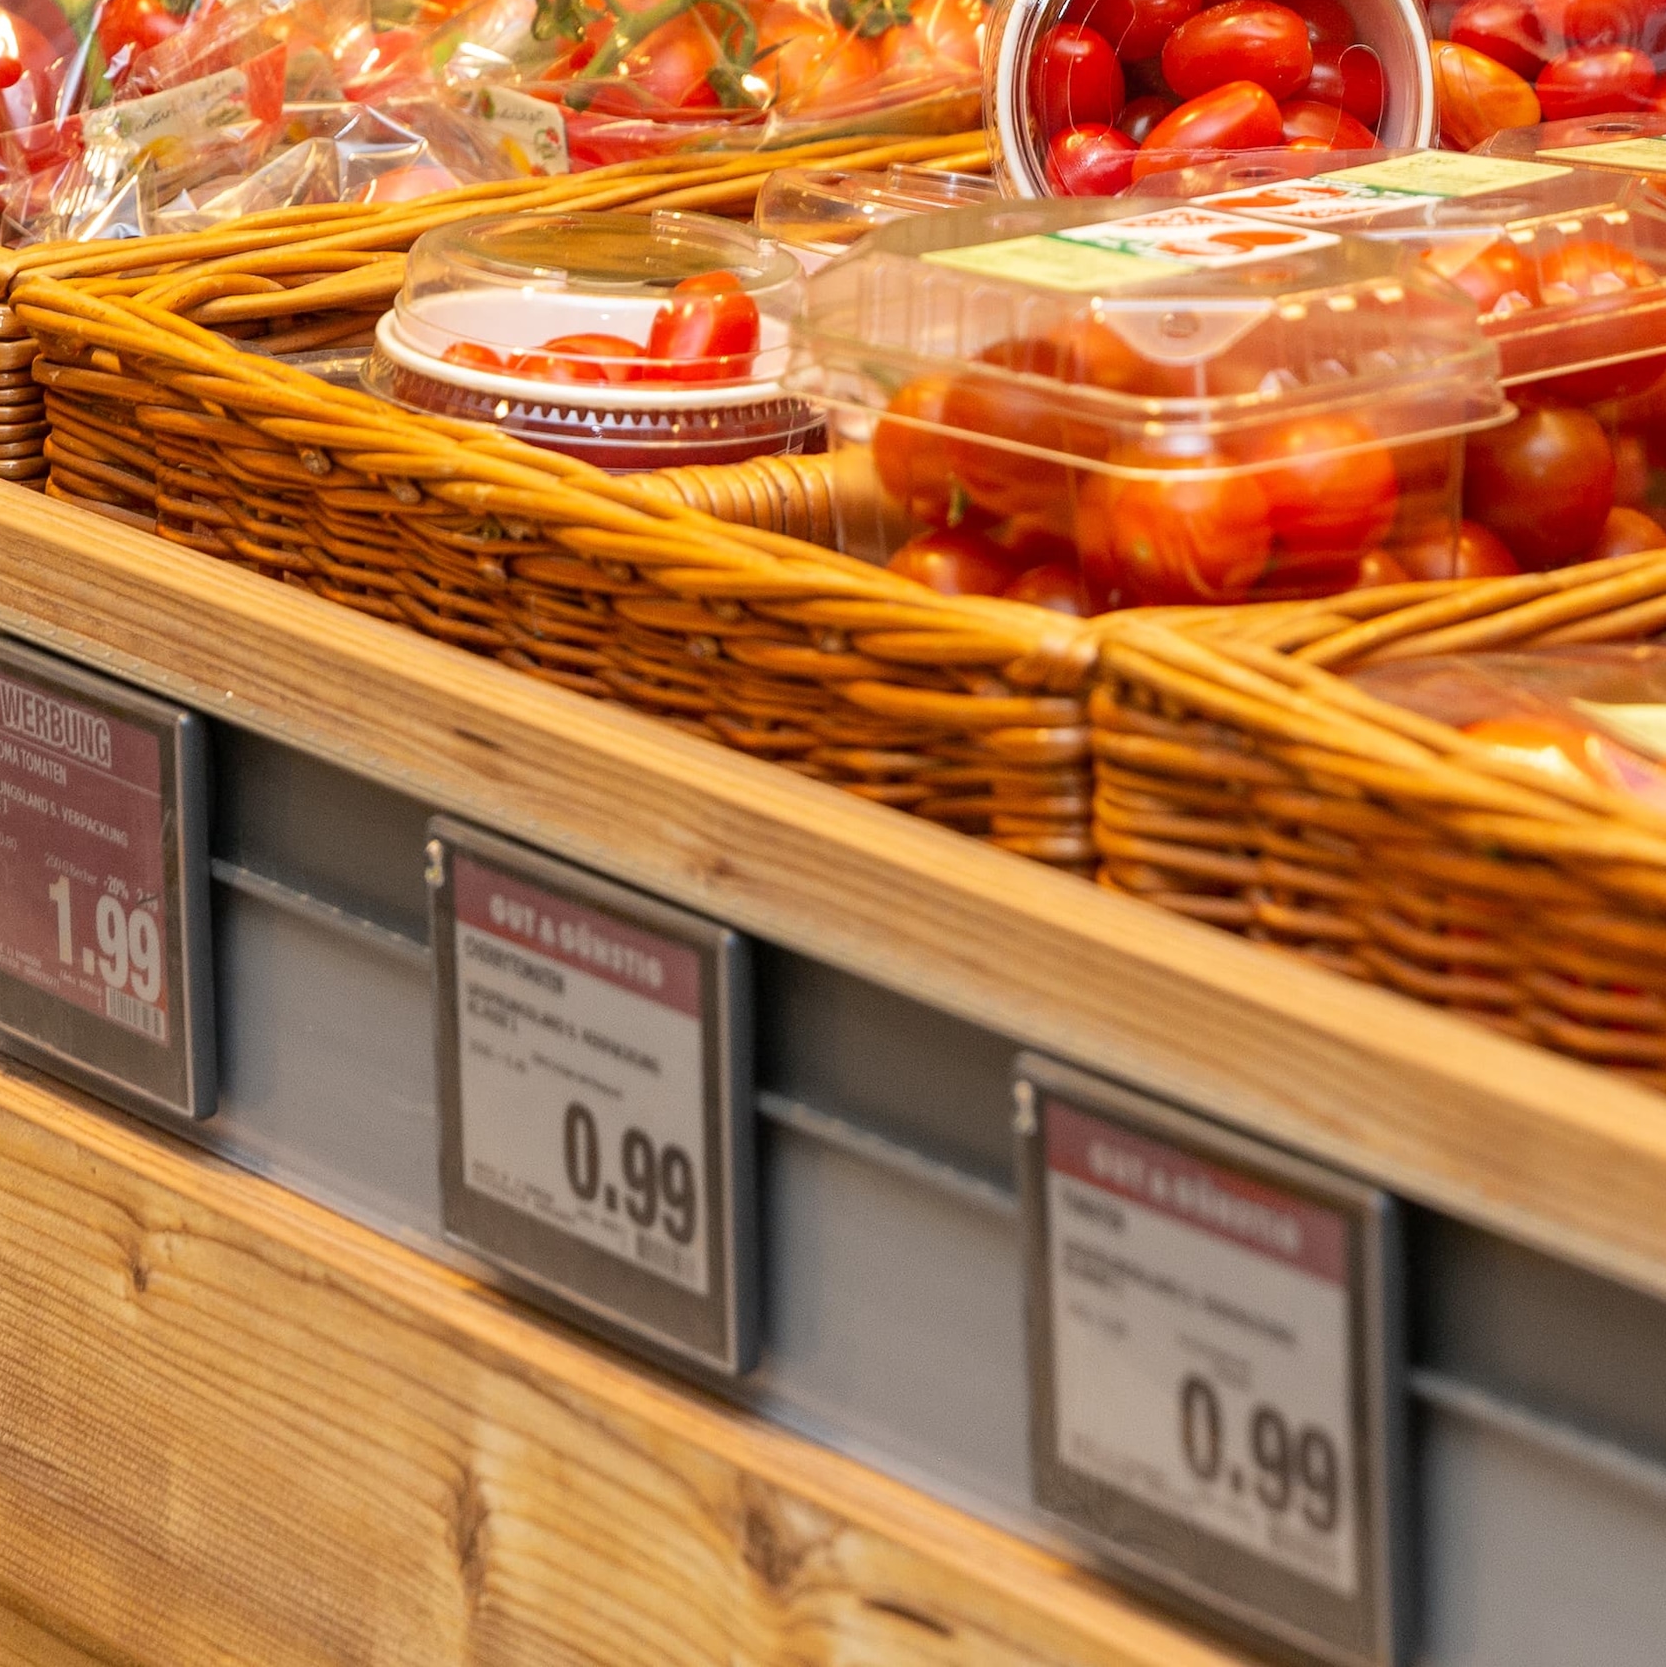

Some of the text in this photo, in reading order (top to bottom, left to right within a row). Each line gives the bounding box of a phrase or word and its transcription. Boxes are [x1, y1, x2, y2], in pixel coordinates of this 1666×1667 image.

[20, 749, 67, 786] TOMATEN
[61, 807, 129, 847] VERPACKUNG
[49, 875, 162, 1005] 1.99
[488, 893, 536, 937] GUT
[563, 1100, 695, 1245] 0.99
[1179, 1372, 1340, 1533] 0.99
